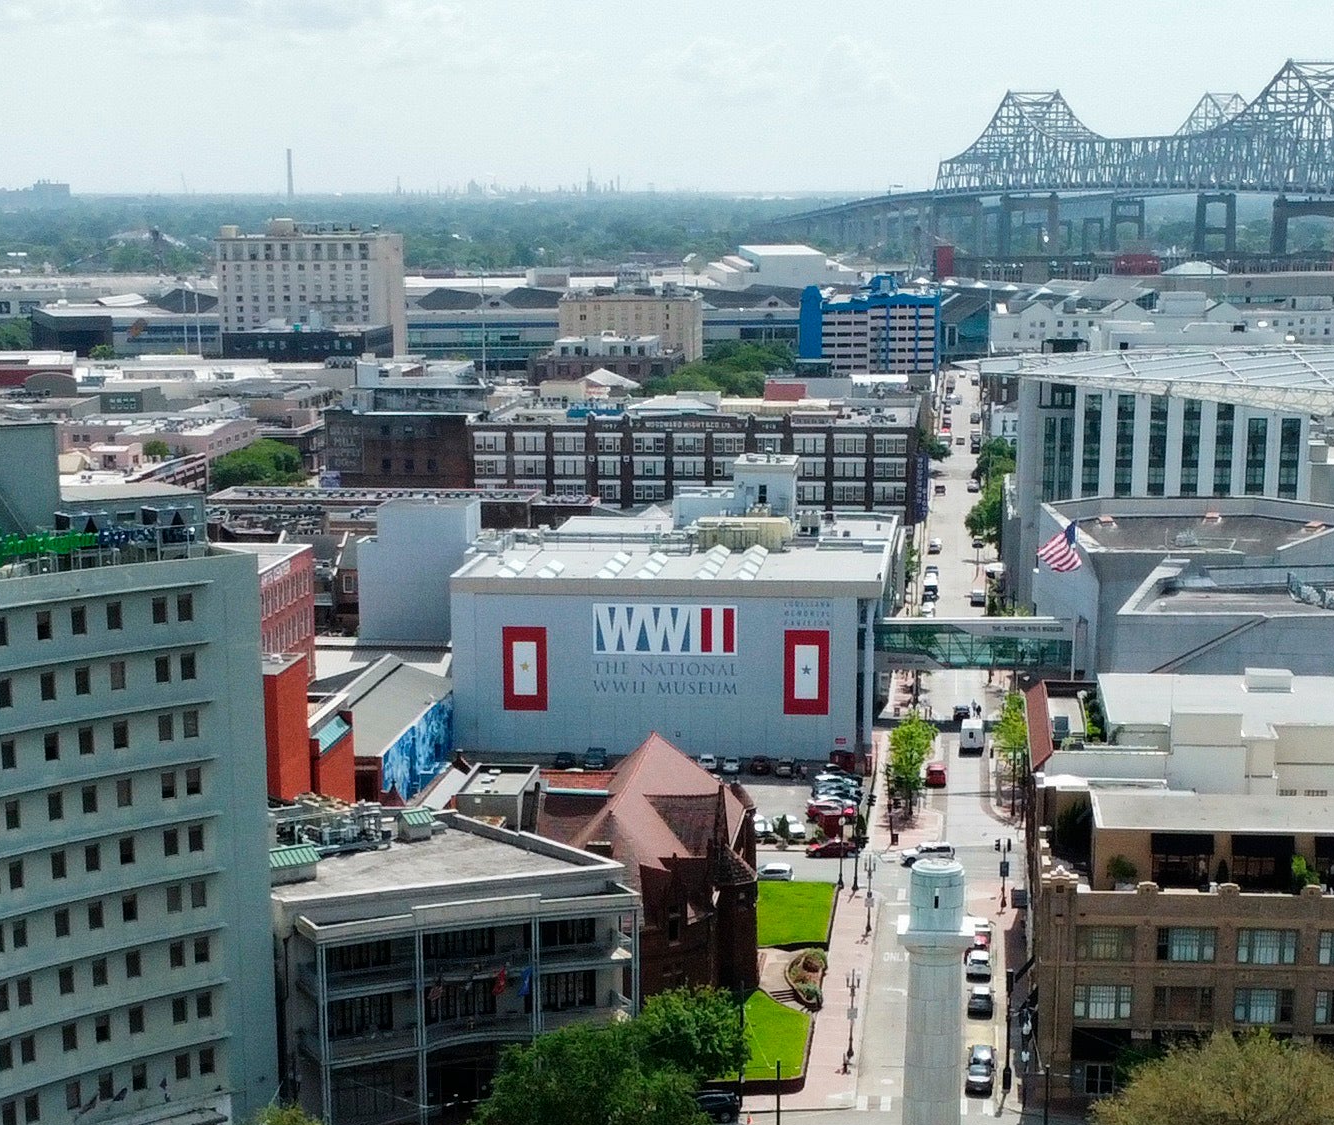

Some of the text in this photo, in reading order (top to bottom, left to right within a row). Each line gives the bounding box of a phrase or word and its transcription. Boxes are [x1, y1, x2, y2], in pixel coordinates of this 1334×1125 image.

[594, 605, 736, 654] WWII
[593, 661, 738, 677] THE NATIONAL
[593, 680, 738, 695] WWII MUSEUM
[882, 951, 910, 962] ONLY
